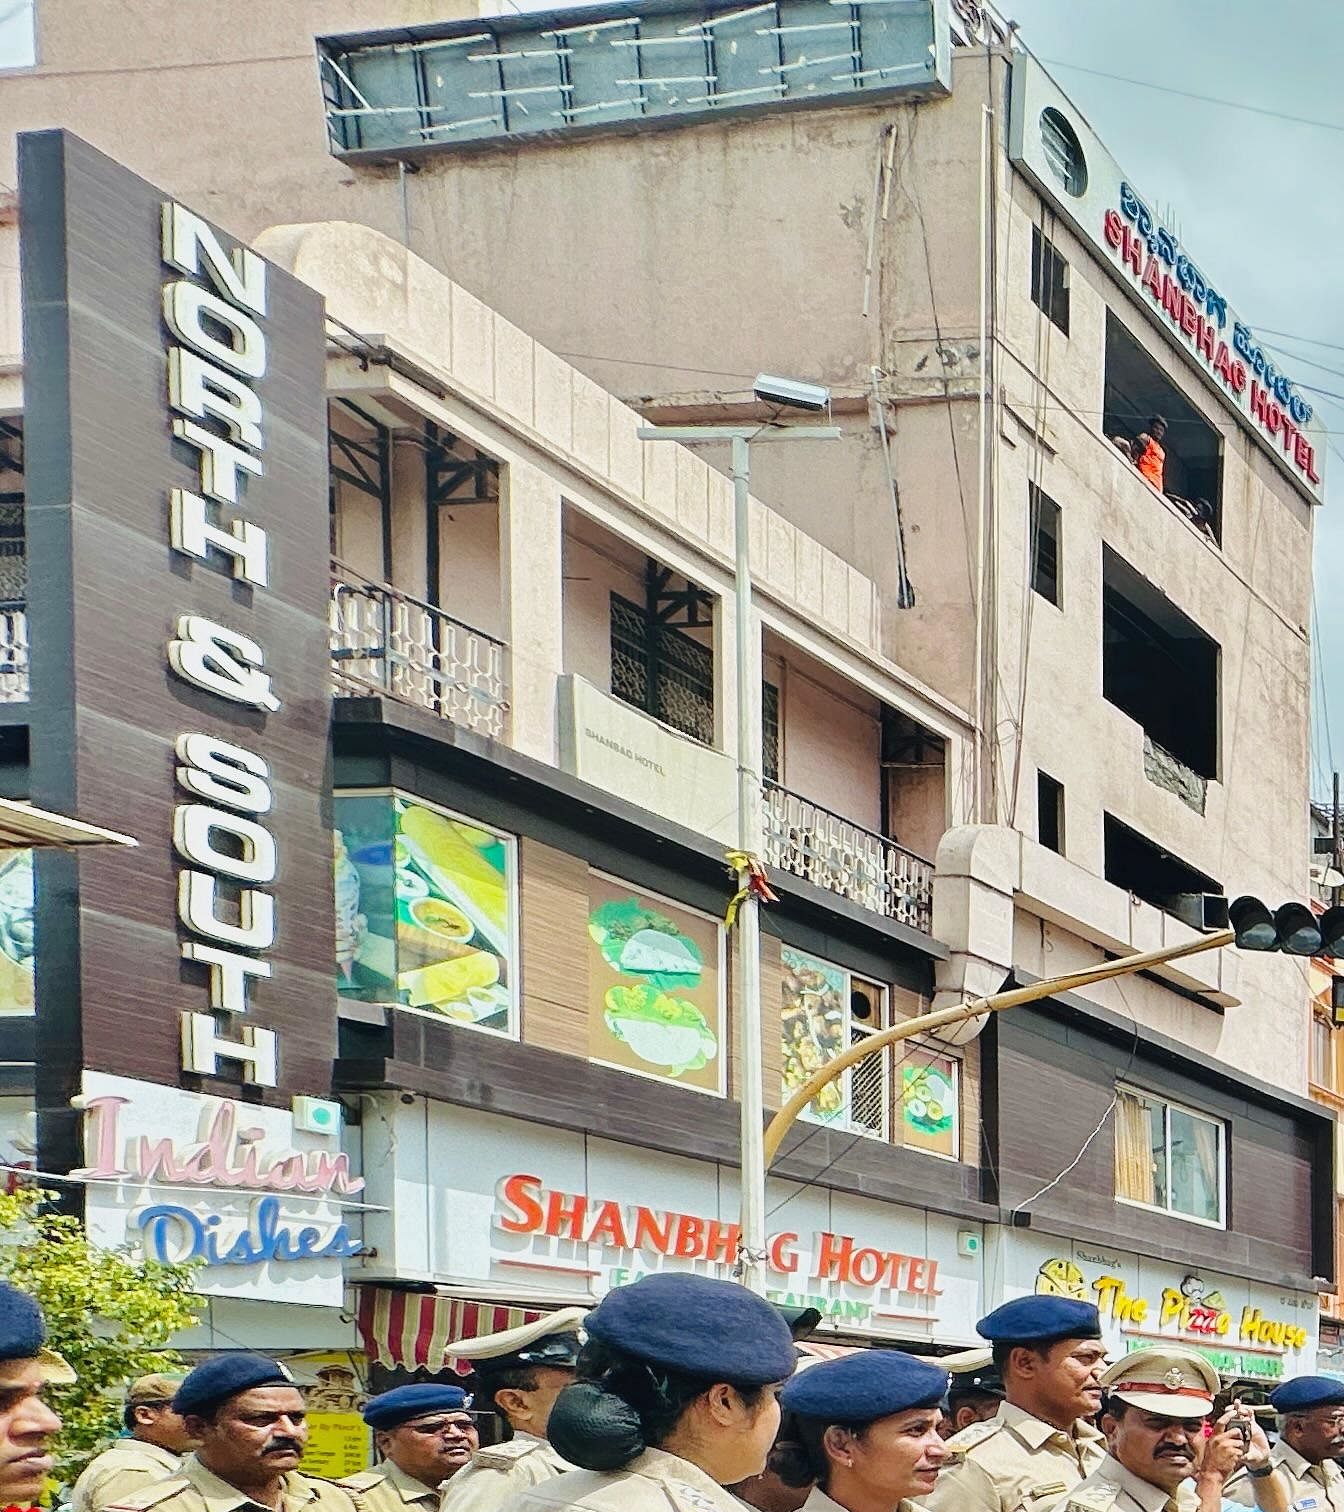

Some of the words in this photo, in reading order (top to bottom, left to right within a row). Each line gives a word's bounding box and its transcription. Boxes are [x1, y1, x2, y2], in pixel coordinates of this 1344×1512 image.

[162, 202, 269, 588] NORTH
[1104, 208, 1247, 392] SHANBHAG
[1249, 380, 1321, 485] HOTEL
[168, 615, 281, 712] &
[173, 732, 279, 1087] SOUTH
[70, 1096, 366, 1193] Indian
[138, 1195, 365, 1266] Dishes
[496, 1173, 800, 1275] SHANBHG
[815, 1230, 944, 1297] HOTEL
[1092, 1275, 1148, 1323] The
[1159, 1287, 1233, 1336] Pizza
[1240, 1305, 1307, 1349] House
